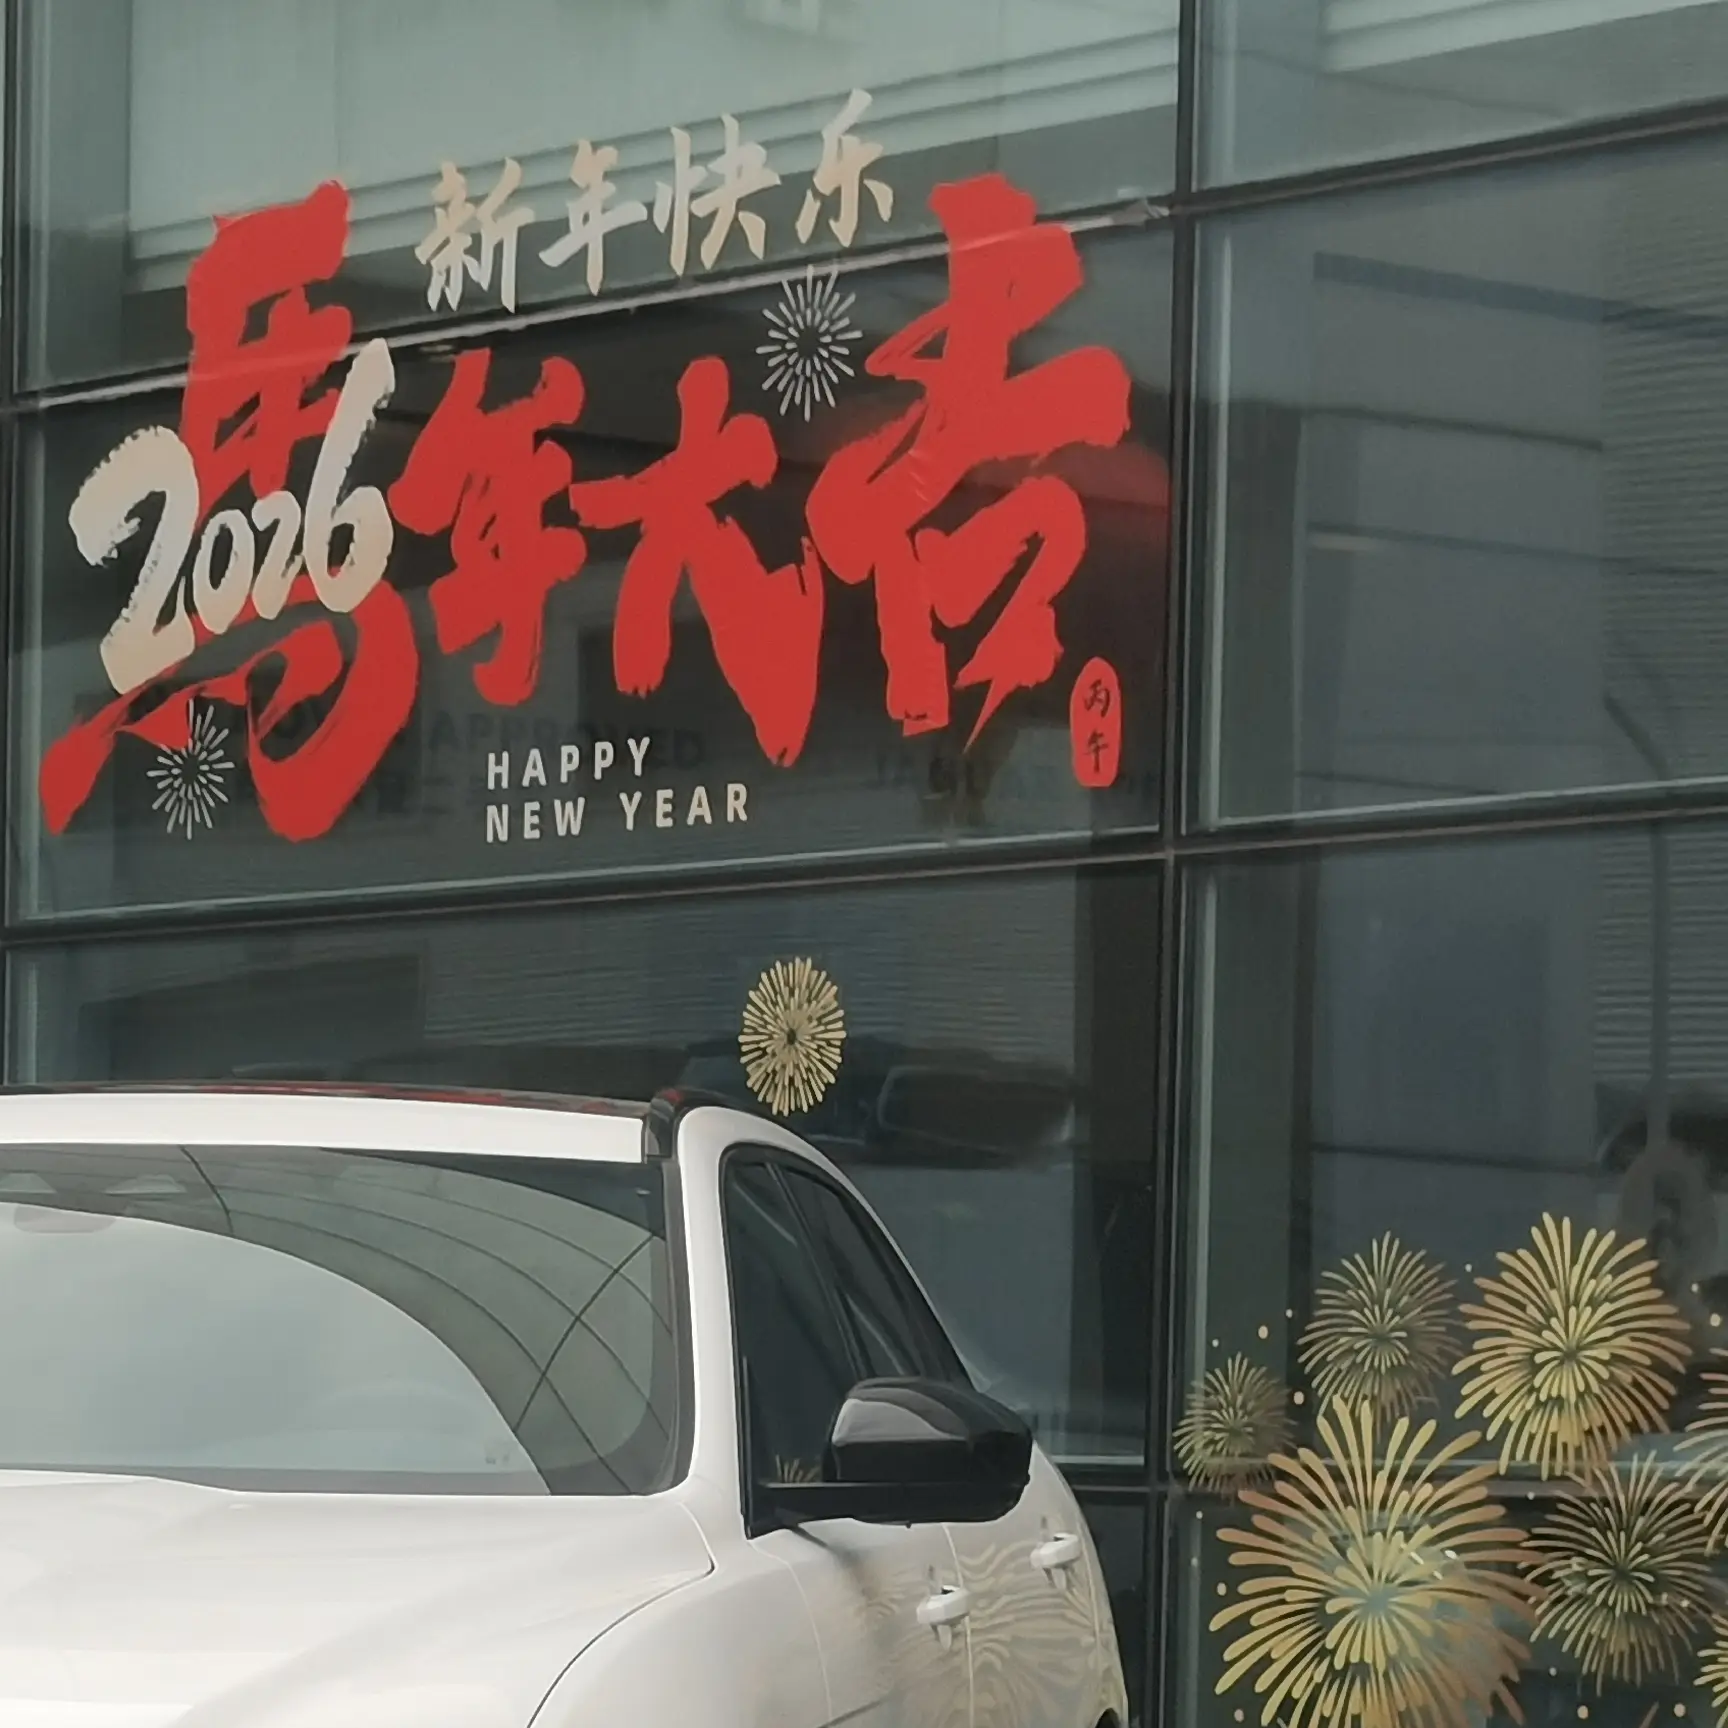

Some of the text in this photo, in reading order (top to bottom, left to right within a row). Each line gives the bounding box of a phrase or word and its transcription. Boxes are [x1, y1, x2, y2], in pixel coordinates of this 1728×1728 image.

[415, 87, 894, 314] 新年快乐
[71, 338, 394, 695] 2026
[487, 736, 651, 791] HAPPY
[1082, 679, 1111, 773] 丙午
[486, 797, 586, 843] NEW
[619, 782, 748, 831] YEAR
